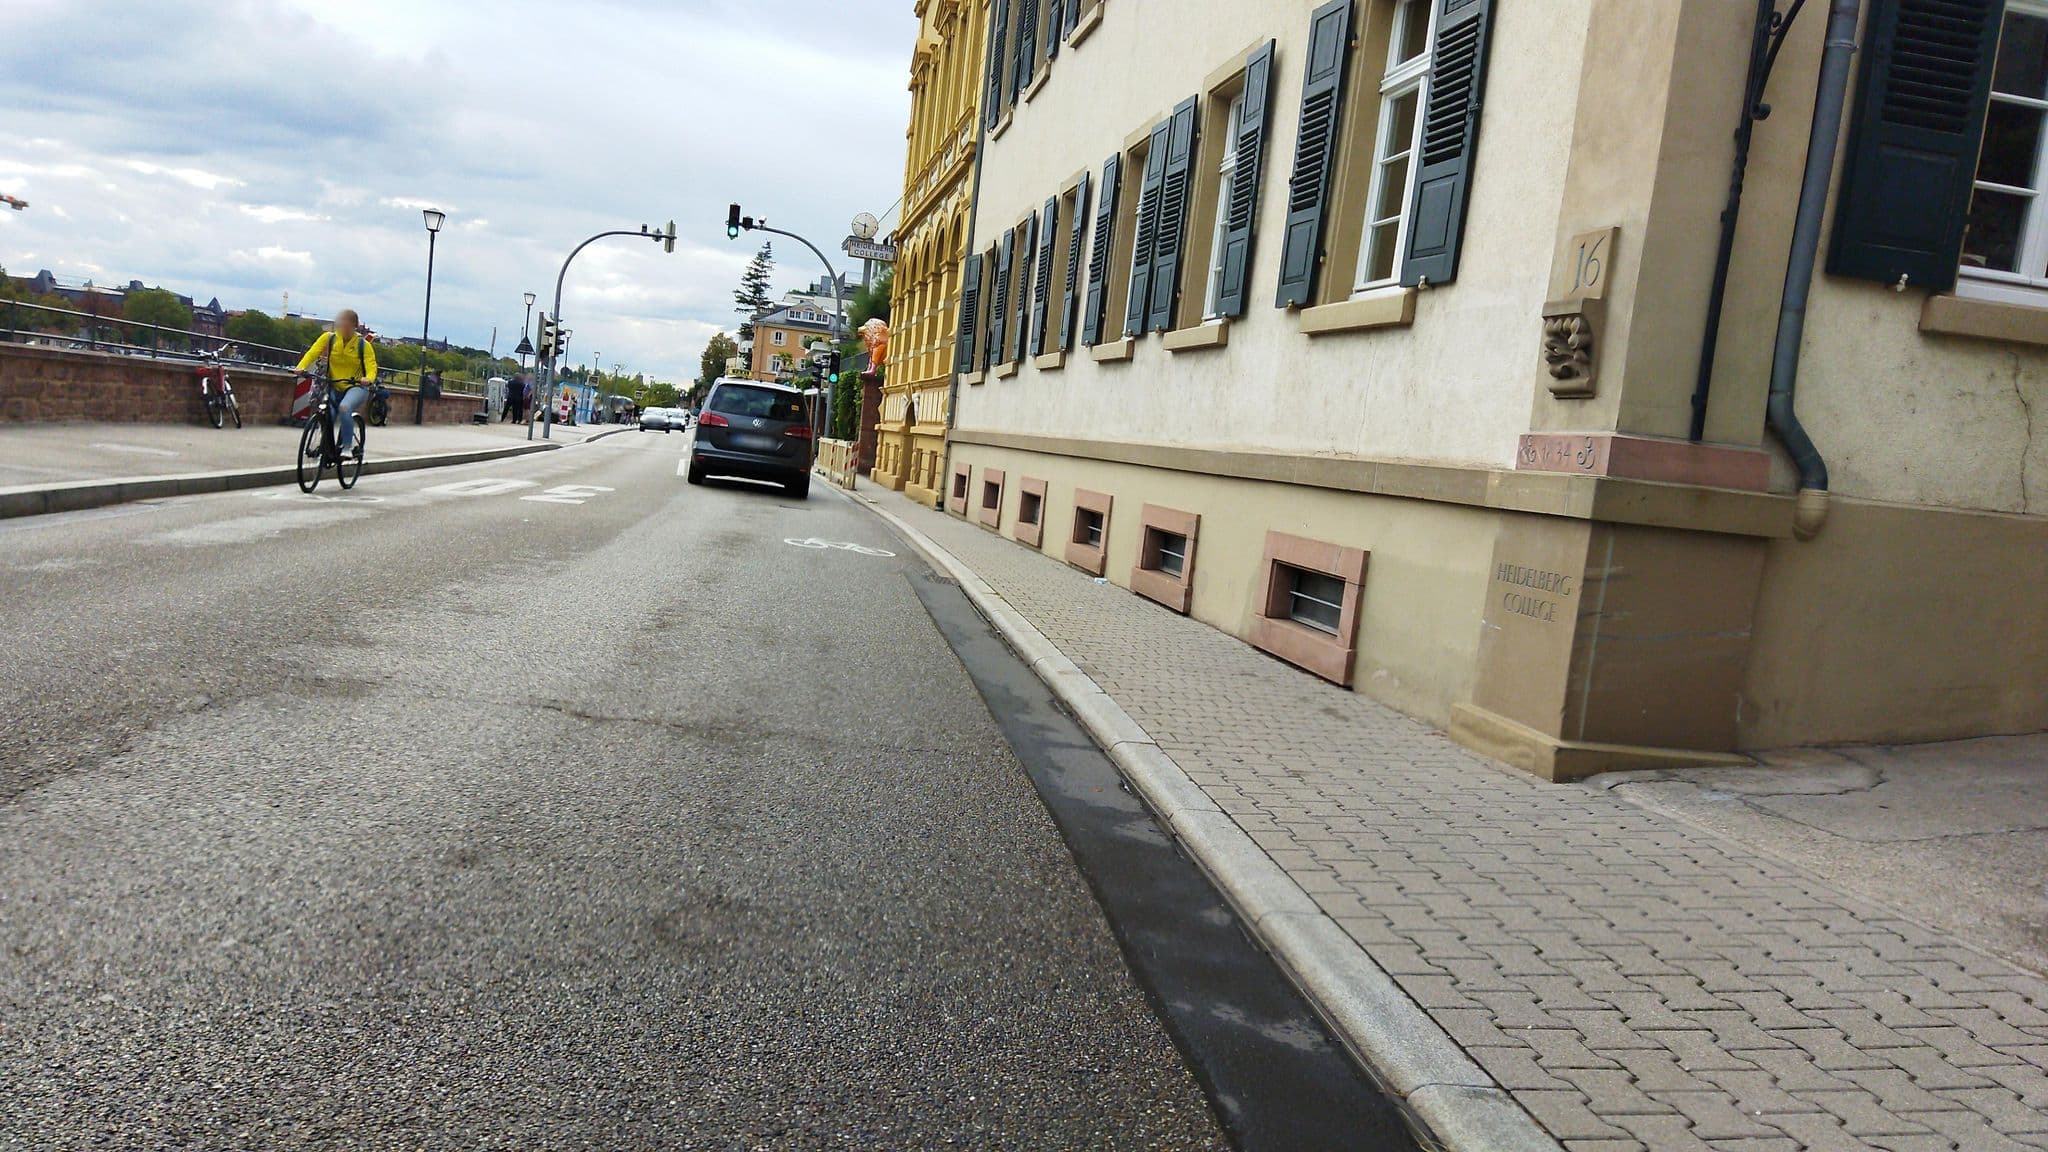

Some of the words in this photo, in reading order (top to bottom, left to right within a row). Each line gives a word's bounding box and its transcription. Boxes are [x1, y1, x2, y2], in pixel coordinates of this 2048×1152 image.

[851, 241, 894, 254] HEIDELBERG
[854, 249, 889, 260] COLLEGE
[1571, 235, 1606, 294] 16
[1497, 562, 1572, 596] HEIDELBERG
[1503, 592, 1557, 623] COLLEGE
